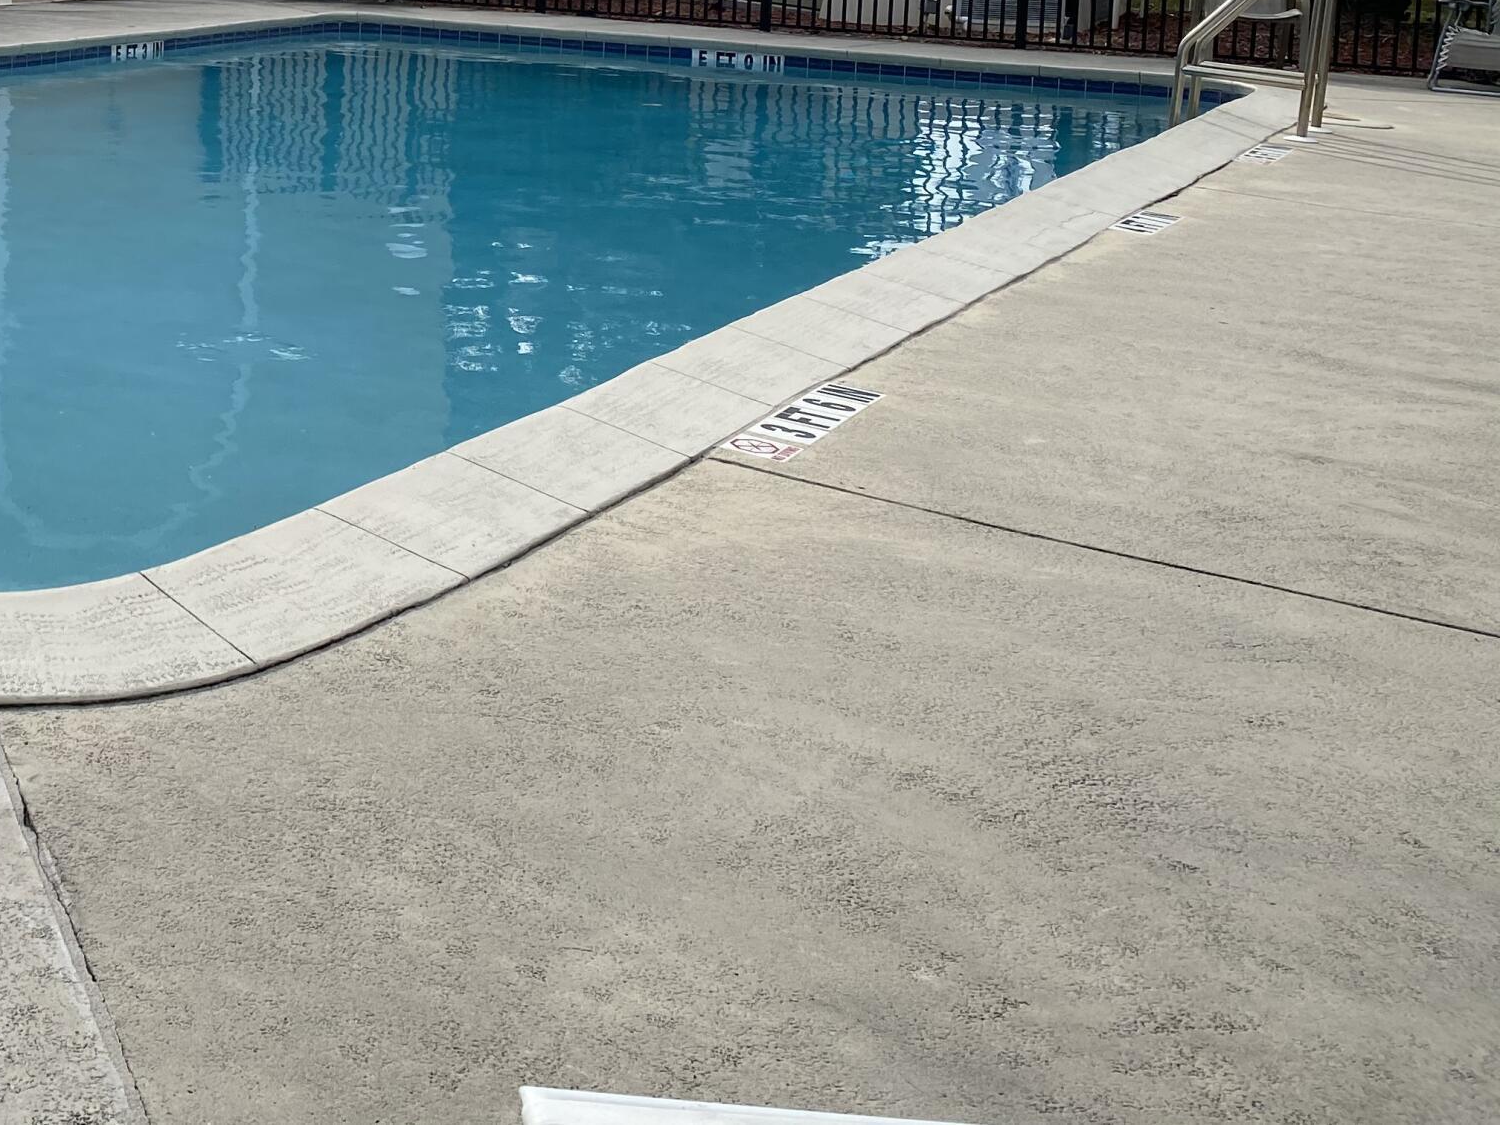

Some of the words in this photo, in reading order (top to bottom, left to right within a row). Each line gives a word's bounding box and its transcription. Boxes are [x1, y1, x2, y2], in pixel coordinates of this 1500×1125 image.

[817, 384, 881, 403] IN
[802, 398, 856, 411] 6
[774, 406, 841, 429] FT
[760, 424, 816, 438] 3
